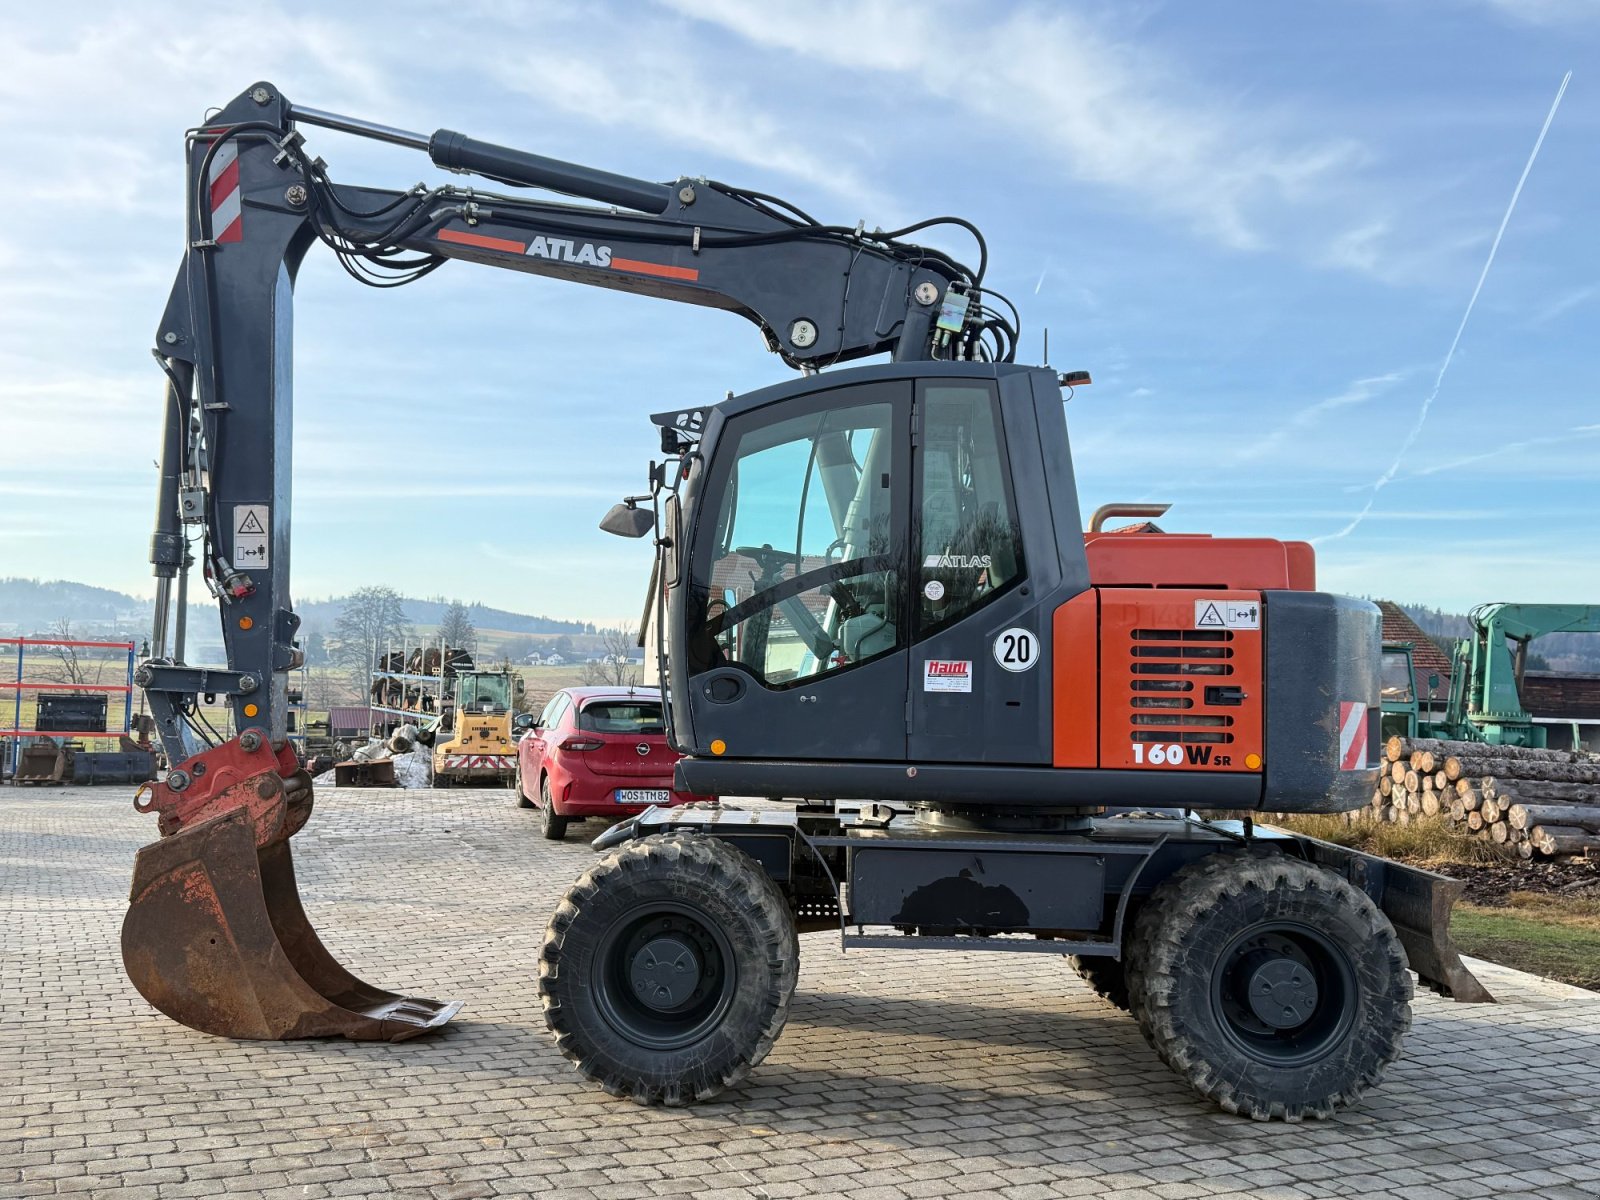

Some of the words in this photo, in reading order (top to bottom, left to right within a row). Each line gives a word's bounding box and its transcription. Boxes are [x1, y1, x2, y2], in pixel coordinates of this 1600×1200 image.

[525, 235, 612, 267] ATLAS
[938, 555, 992, 568] ATLAS
[1003, 635, 1030, 663] 20
